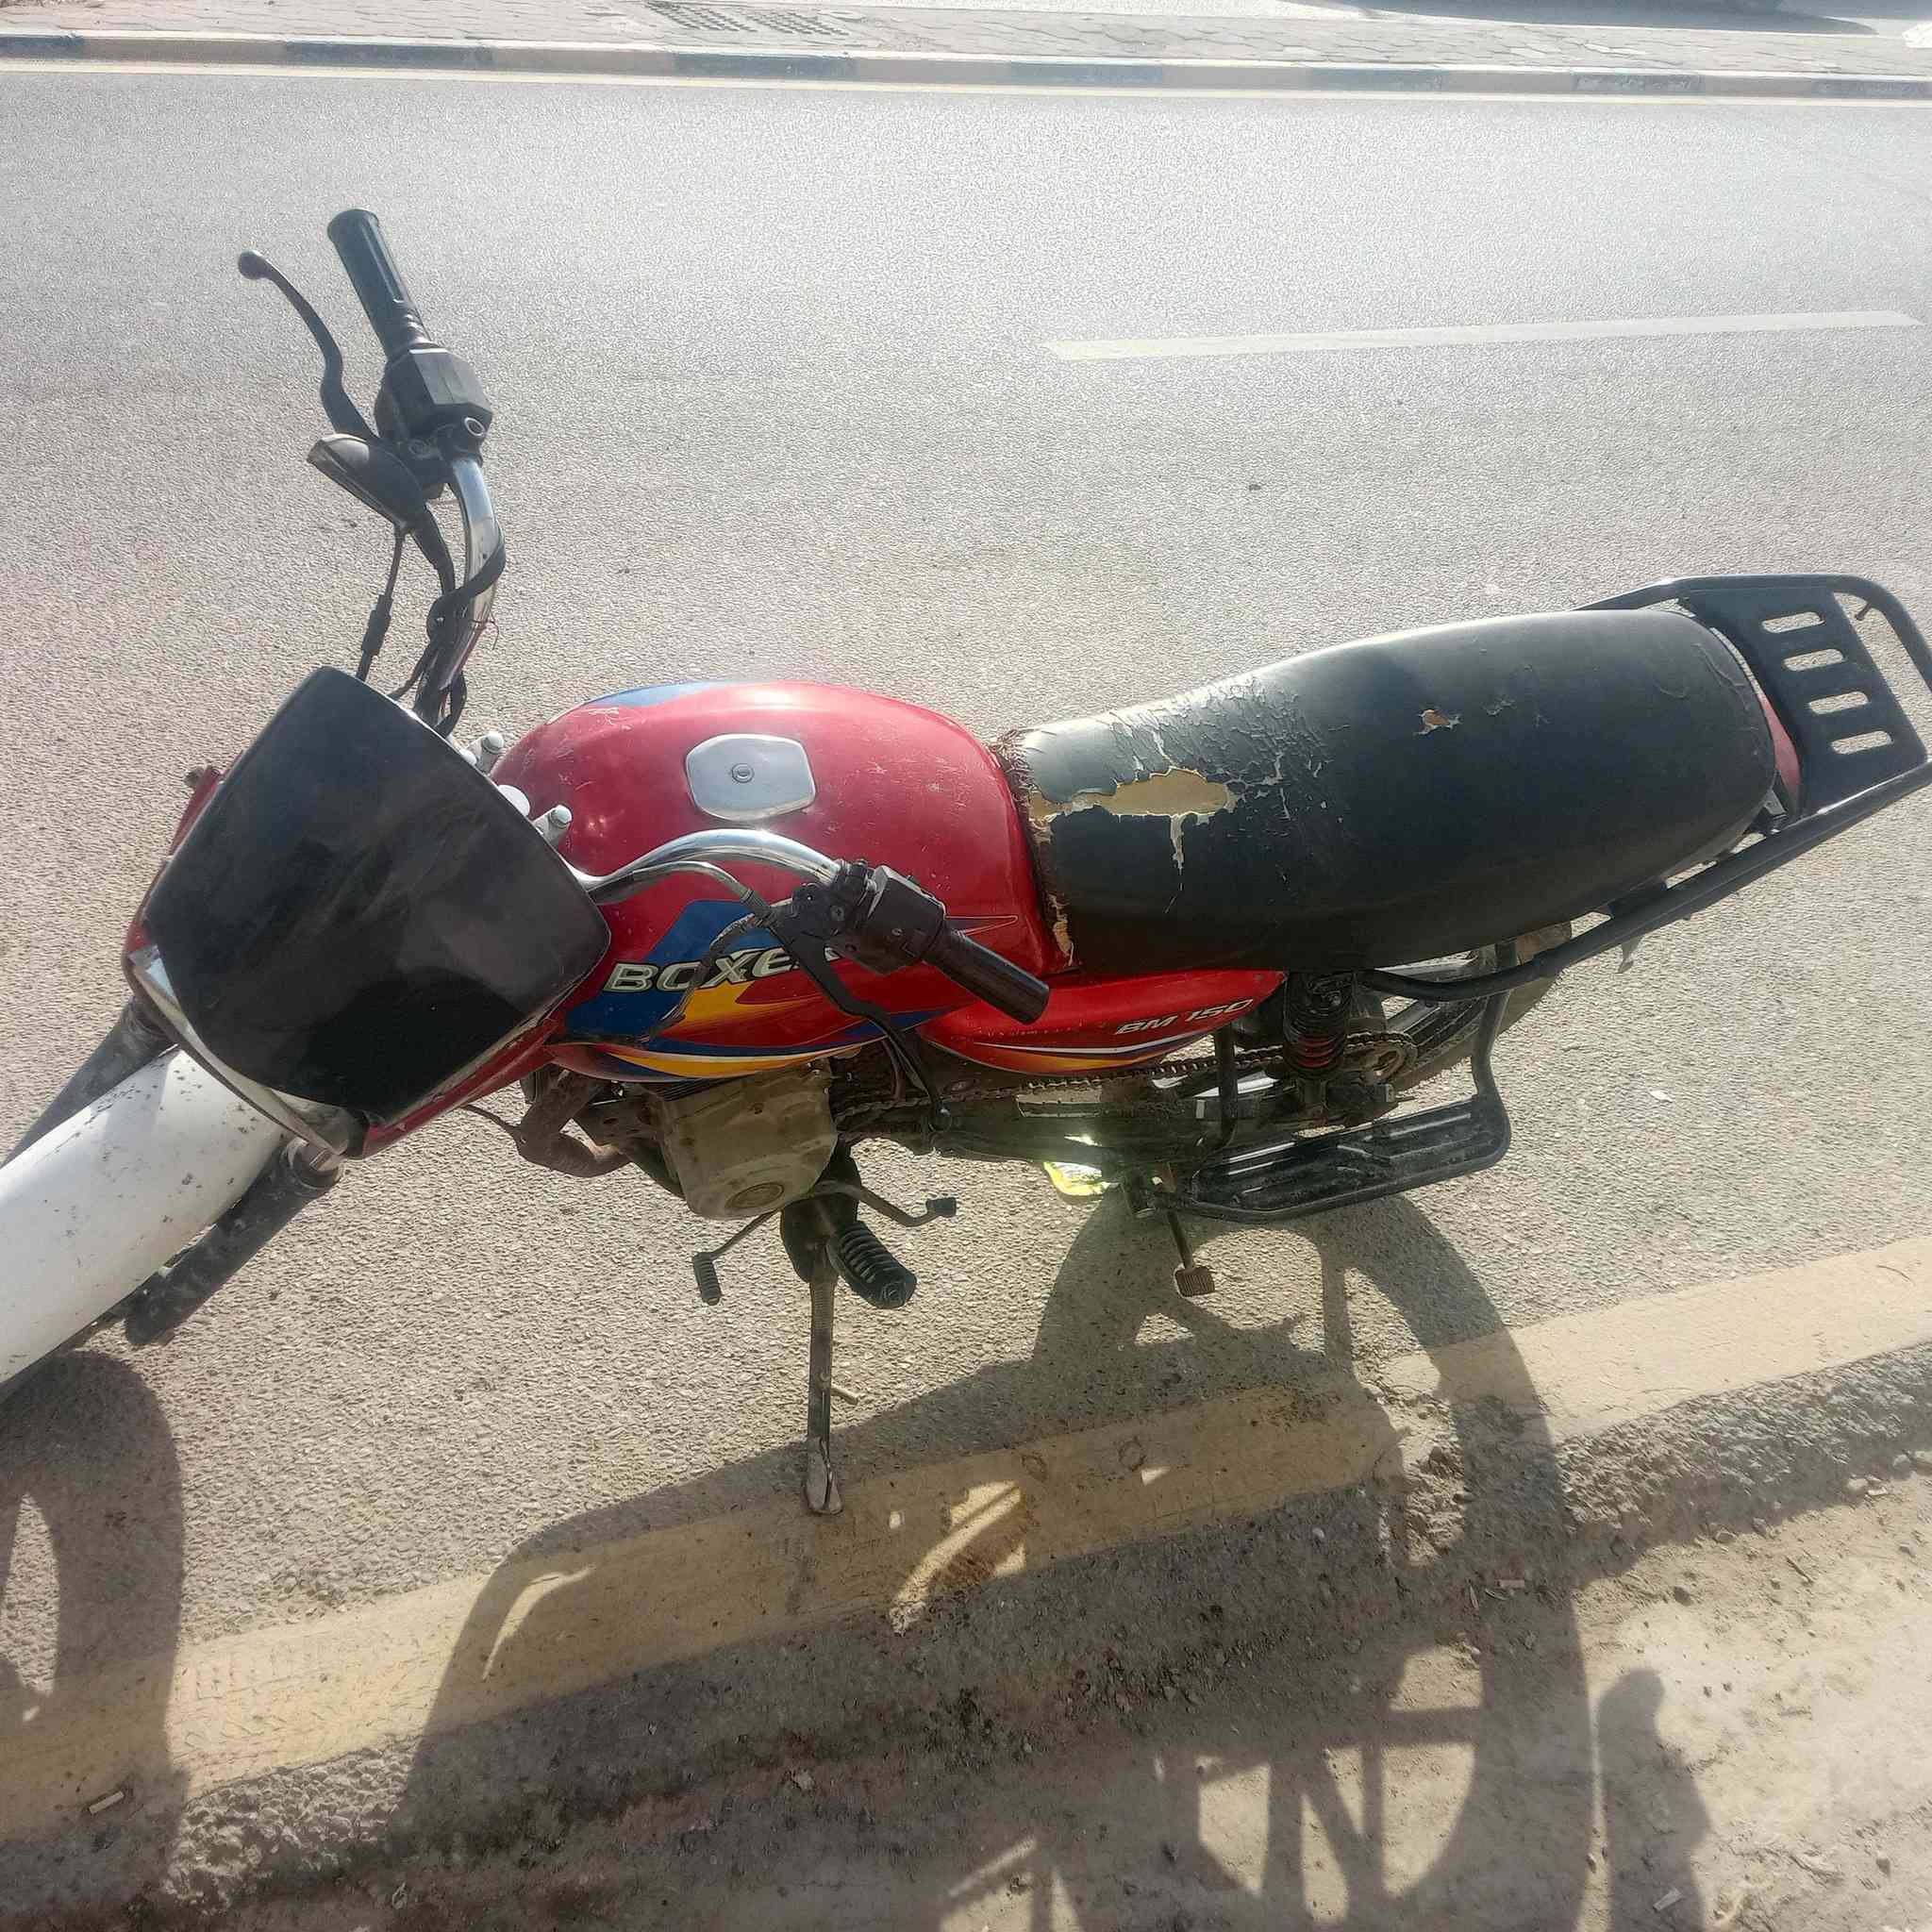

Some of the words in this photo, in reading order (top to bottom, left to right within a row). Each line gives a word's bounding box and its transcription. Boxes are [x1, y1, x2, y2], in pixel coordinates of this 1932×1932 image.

[603, 945, 841, 992] BOXE
[1114, 1014, 1178, 1035] BM
[1185, 998, 1254, 1022] 150
